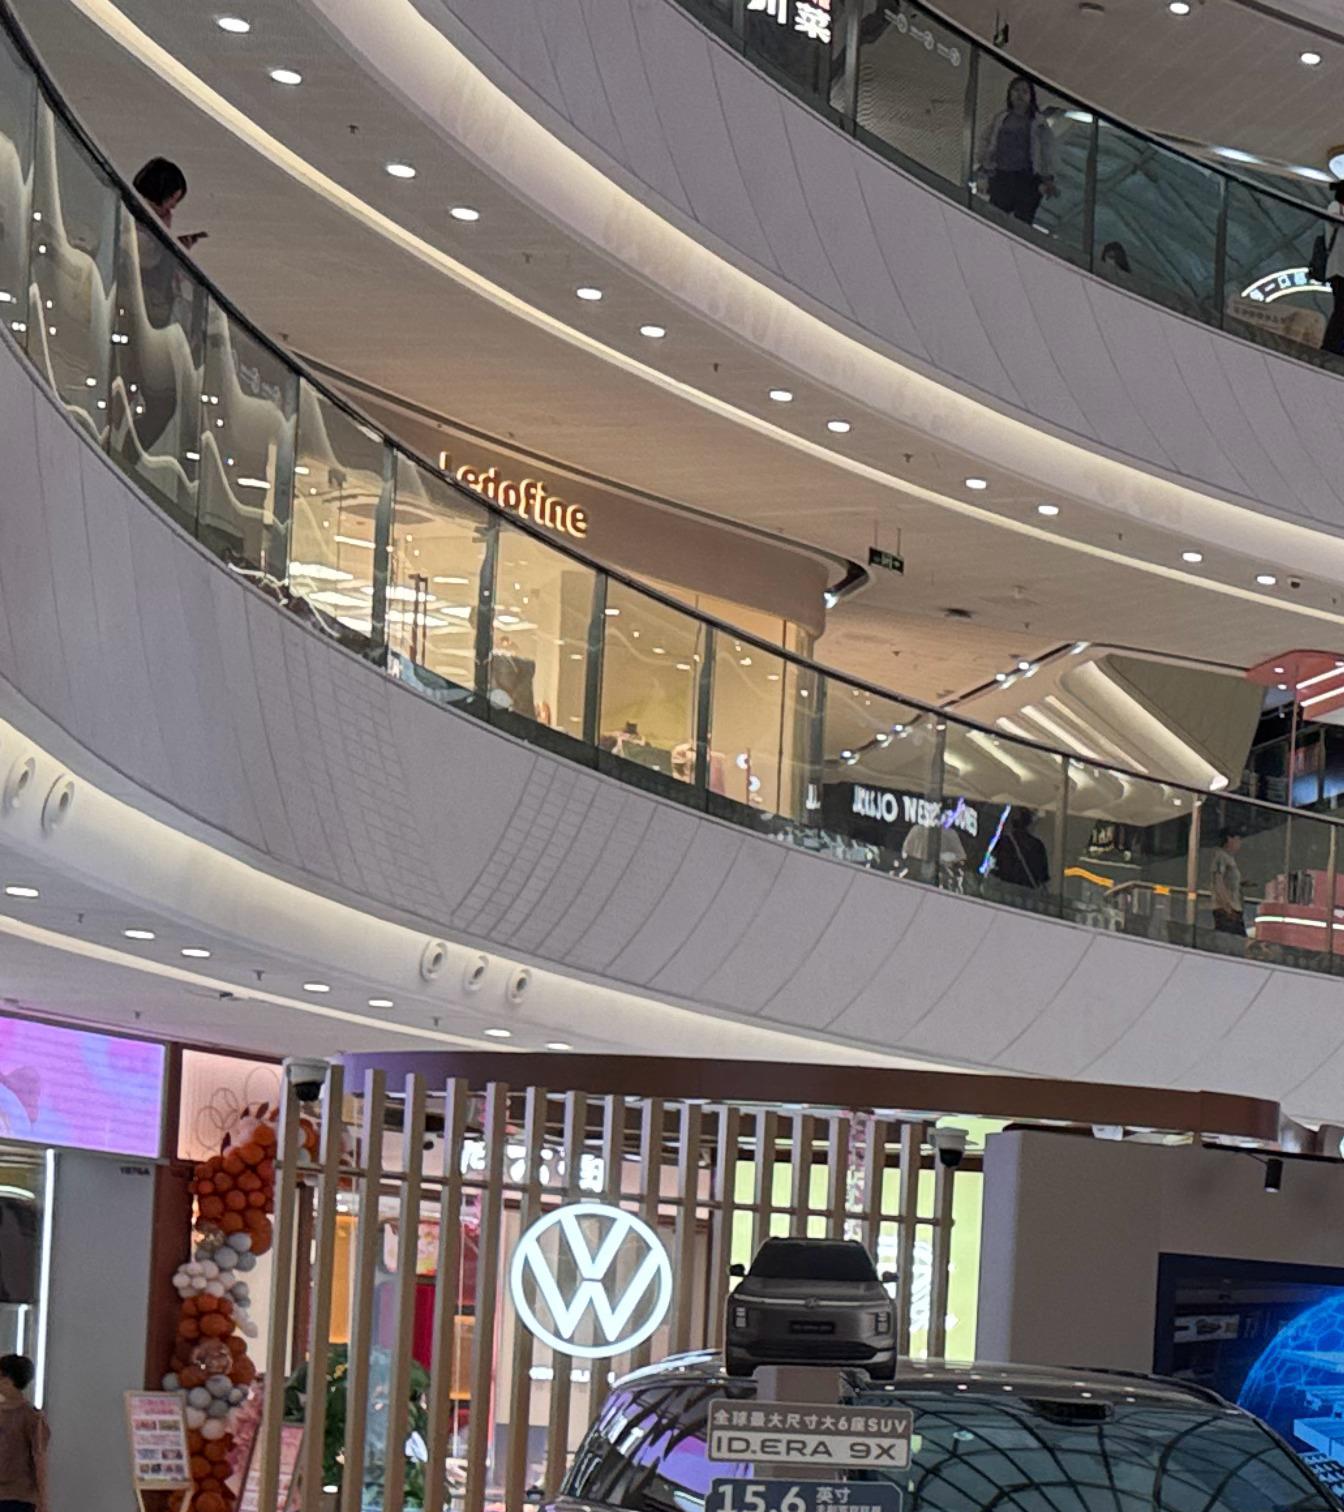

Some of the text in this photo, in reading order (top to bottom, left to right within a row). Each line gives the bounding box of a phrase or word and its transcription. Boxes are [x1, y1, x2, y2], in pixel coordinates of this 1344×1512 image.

[714, 1408, 907, 1435] 全球最大尺寸大6座SUV
[715, 1435, 898, 1461] ID.ERA 9X
[815, 1486, 852, 1505] 英寸
